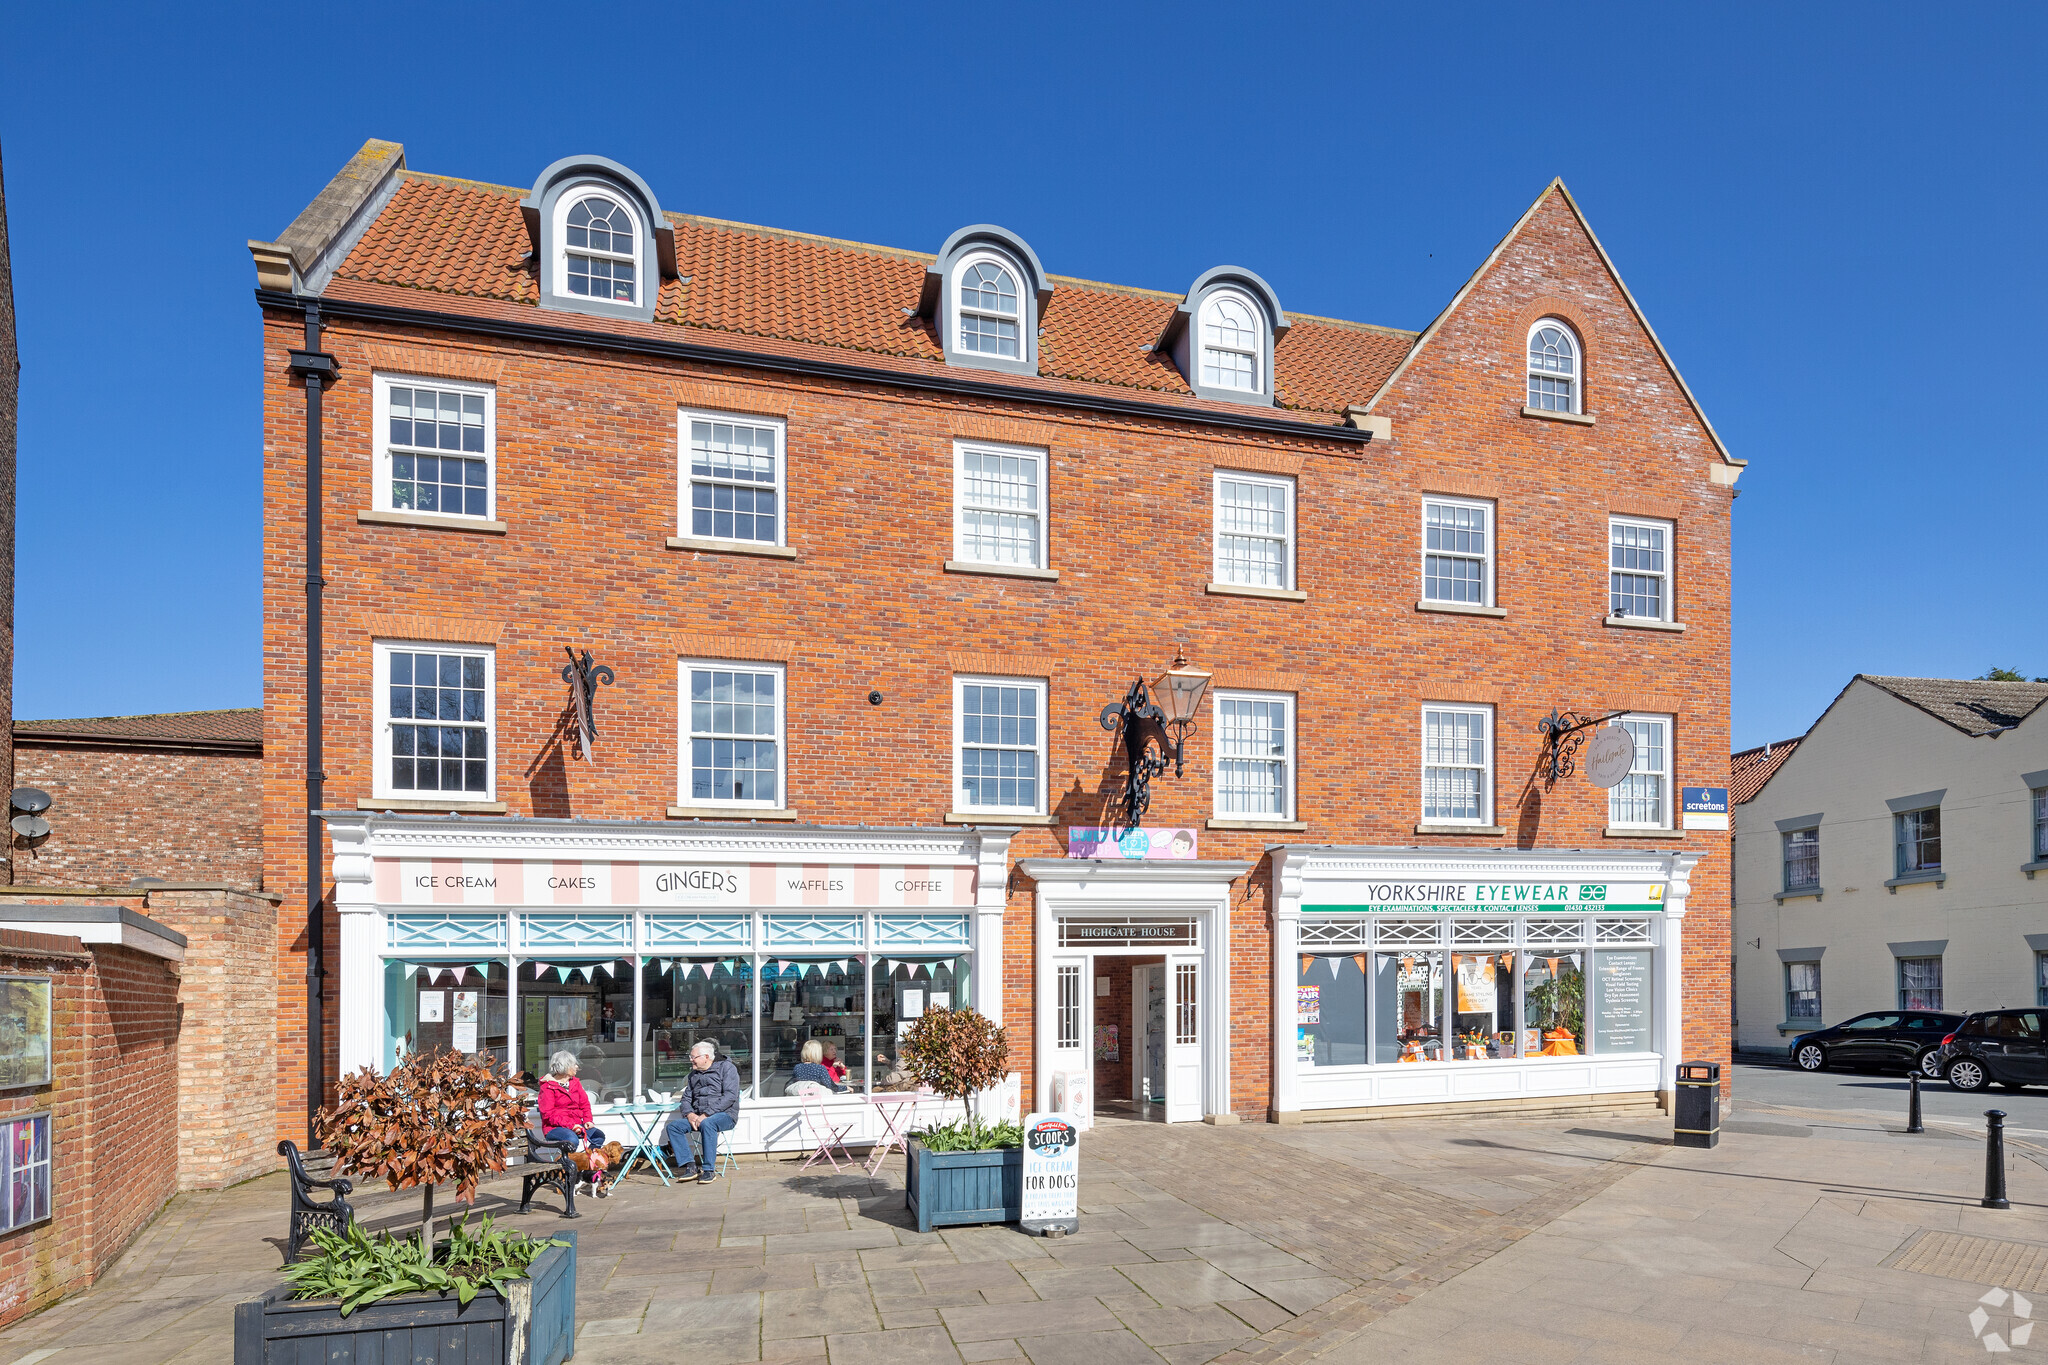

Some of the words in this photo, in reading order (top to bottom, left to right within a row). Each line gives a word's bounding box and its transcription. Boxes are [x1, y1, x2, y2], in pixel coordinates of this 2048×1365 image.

[1686, 801, 1725, 811] screetons
[414, 875, 440, 888] ICE
[444, 876, 498, 889] CREAM
[547, 877, 596, 889] CAKES
[787, 880, 844, 892] WAFFLES
[894, 880, 942, 892] COFFEE
[1368, 884, 1467, 901] YORKSHIRE
[1476, 885, 1569, 901] EYEWEAR
[1382, 905, 1435, 913] EXAMINATIONS,
[1080, 927, 1136, 937] HIGHGATE
[1141, 927, 1176, 937] HOUSE
[1034, 1130, 1070, 1146] SCOOP'S
[1029, 1162, 1043, 1174] ICE
[1045, 1160, 1073, 1173] CREAM
[1026, 1175, 1045, 1190] FOR
[1049, 1174, 1076, 1190] DOGS
